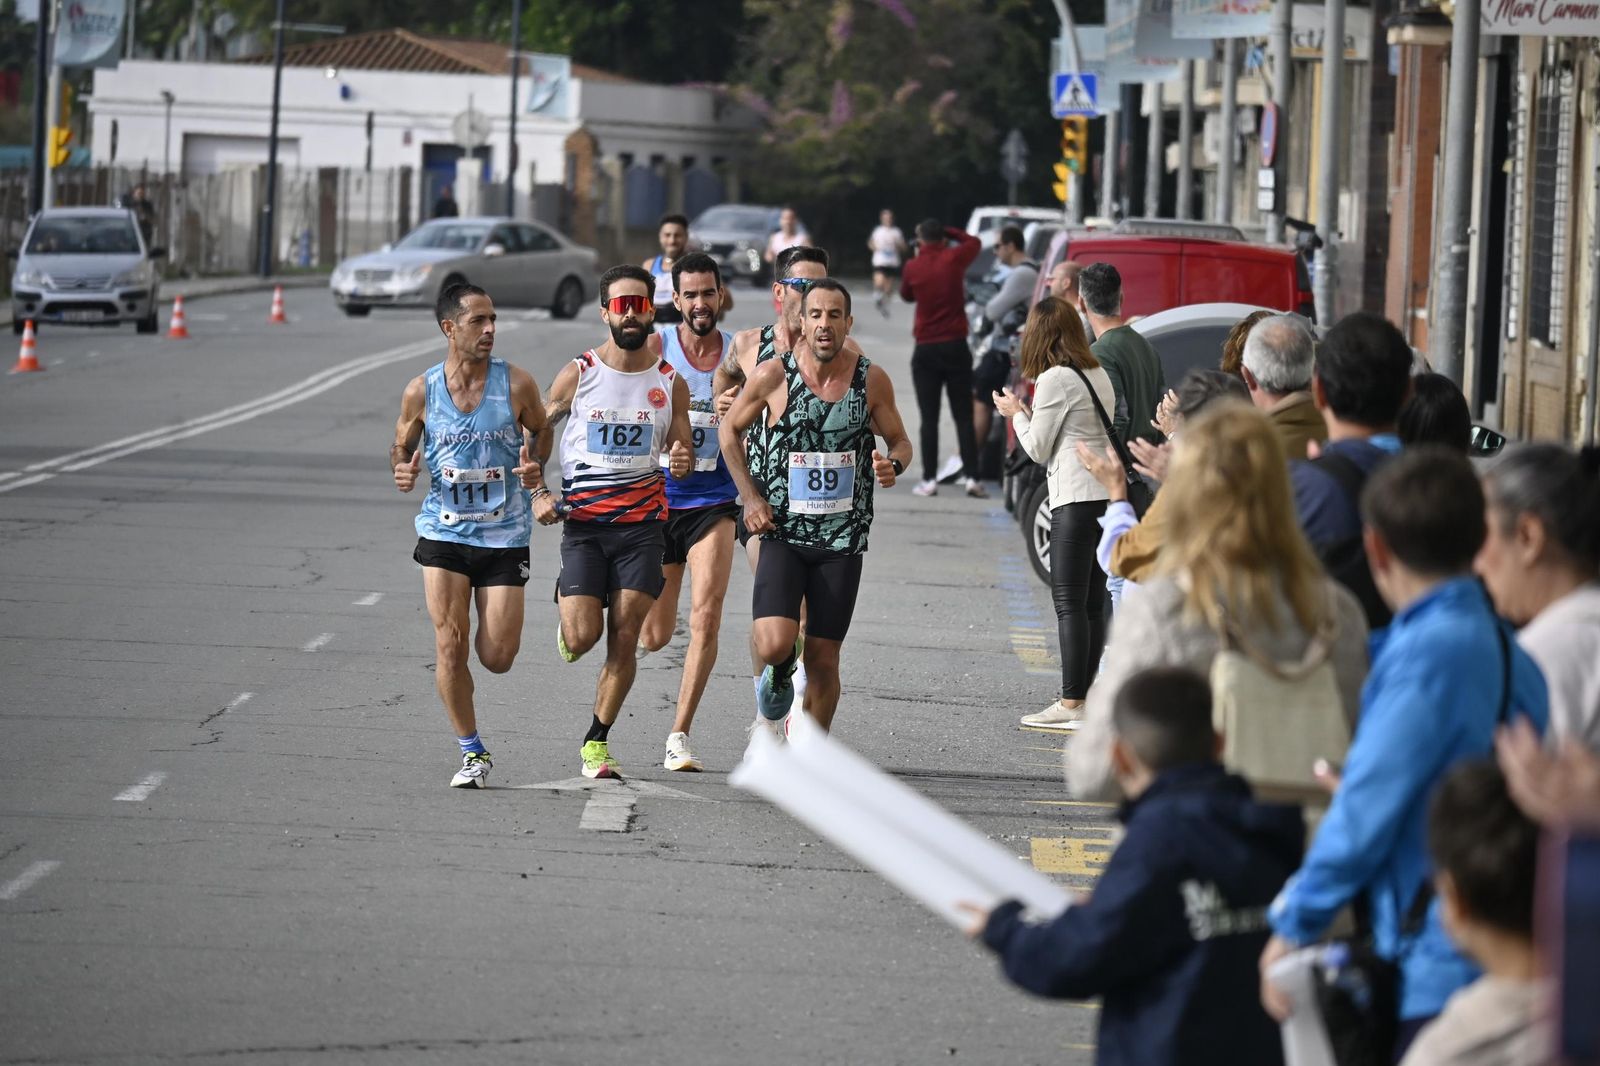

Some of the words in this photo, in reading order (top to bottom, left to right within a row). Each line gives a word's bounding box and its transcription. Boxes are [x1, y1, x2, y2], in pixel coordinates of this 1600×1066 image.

[1488, 0, 1534, 26] Mari
[1539, 0, 1600, 25] Carmen
[591, 410, 604, 420] 2K
[637, 411, 650, 421] 2K
[598, 424, 642, 446] 162
[692, 428, 705, 448] 9
[603, 456, 632, 464] Huelva
[793, 454, 806, 464] 2K
[841, 454, 853, 464] 2K
[808, 468, 838, 491] 89
[449, 482, 489, 505] 111
[806, 501, 836, 509] Huelva
